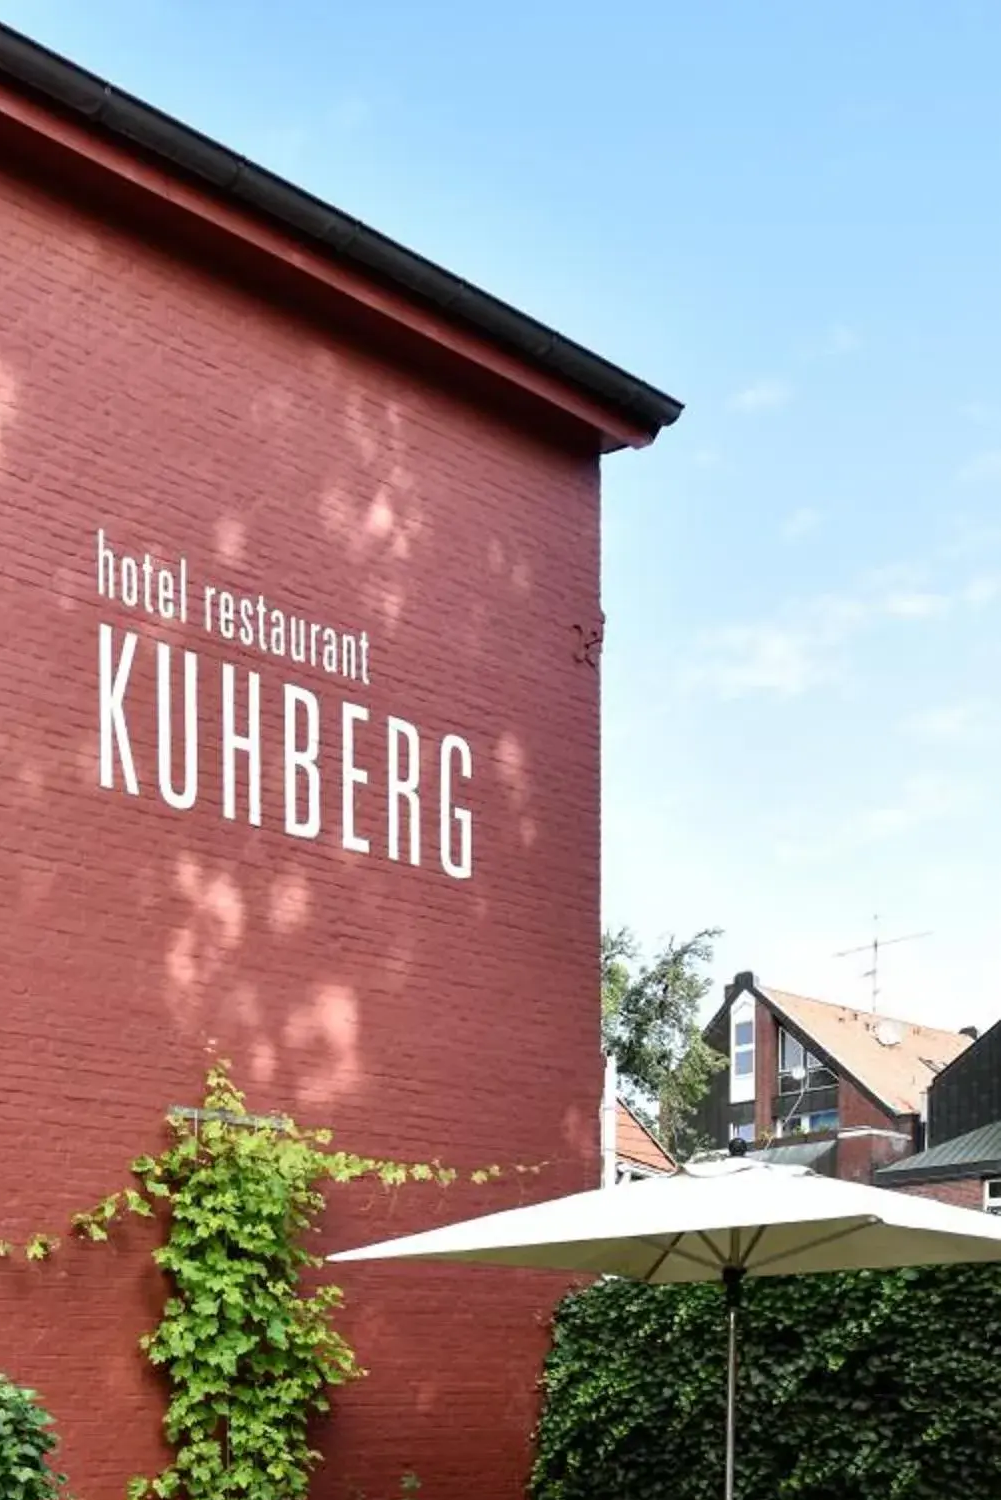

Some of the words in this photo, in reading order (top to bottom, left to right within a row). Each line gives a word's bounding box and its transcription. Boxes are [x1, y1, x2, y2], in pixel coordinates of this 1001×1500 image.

[98, 528, 187, 623] hotel
[204, 585, 370, 684] restaurant
[99, 623, 473, 879] KUHBERG
